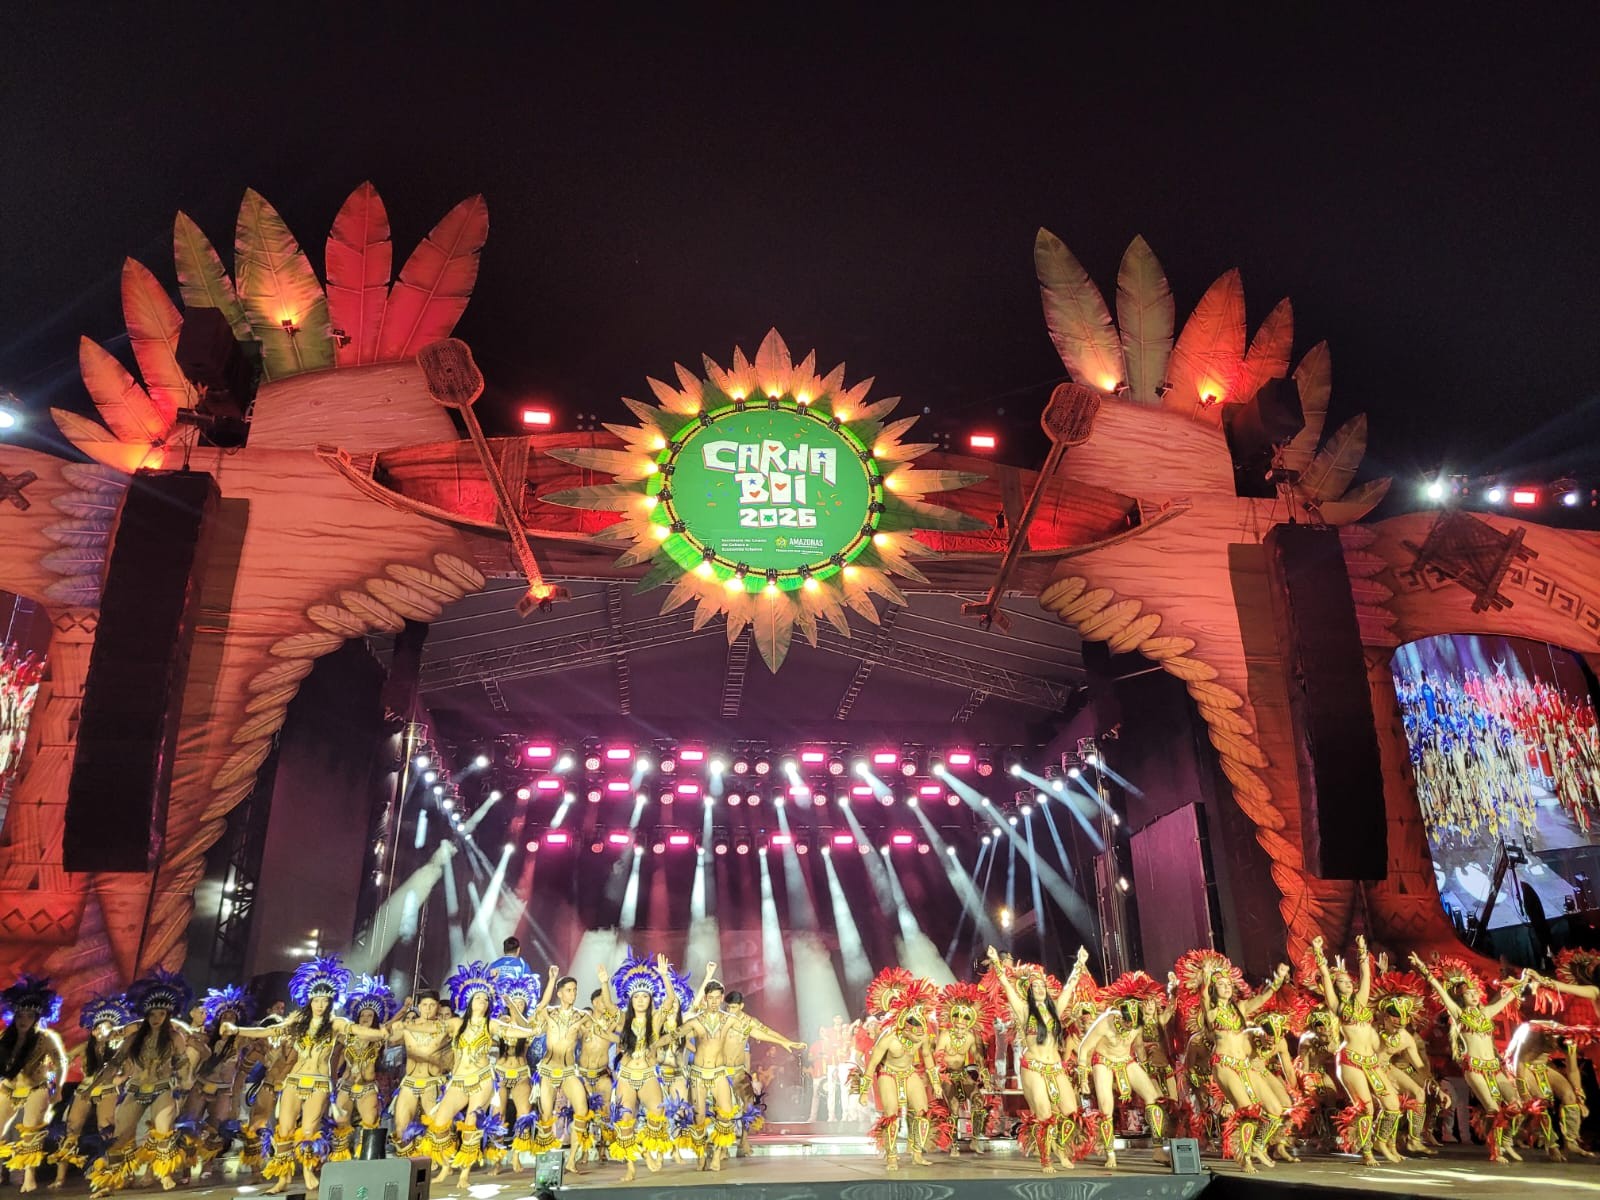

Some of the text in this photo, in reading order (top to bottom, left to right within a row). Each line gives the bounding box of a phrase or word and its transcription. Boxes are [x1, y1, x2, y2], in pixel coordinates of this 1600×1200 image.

[702, 439, 837, 487] CARNA
[739, 507, 817, 529] 2026
[789, 537, 824, 547] AMAZONAS
